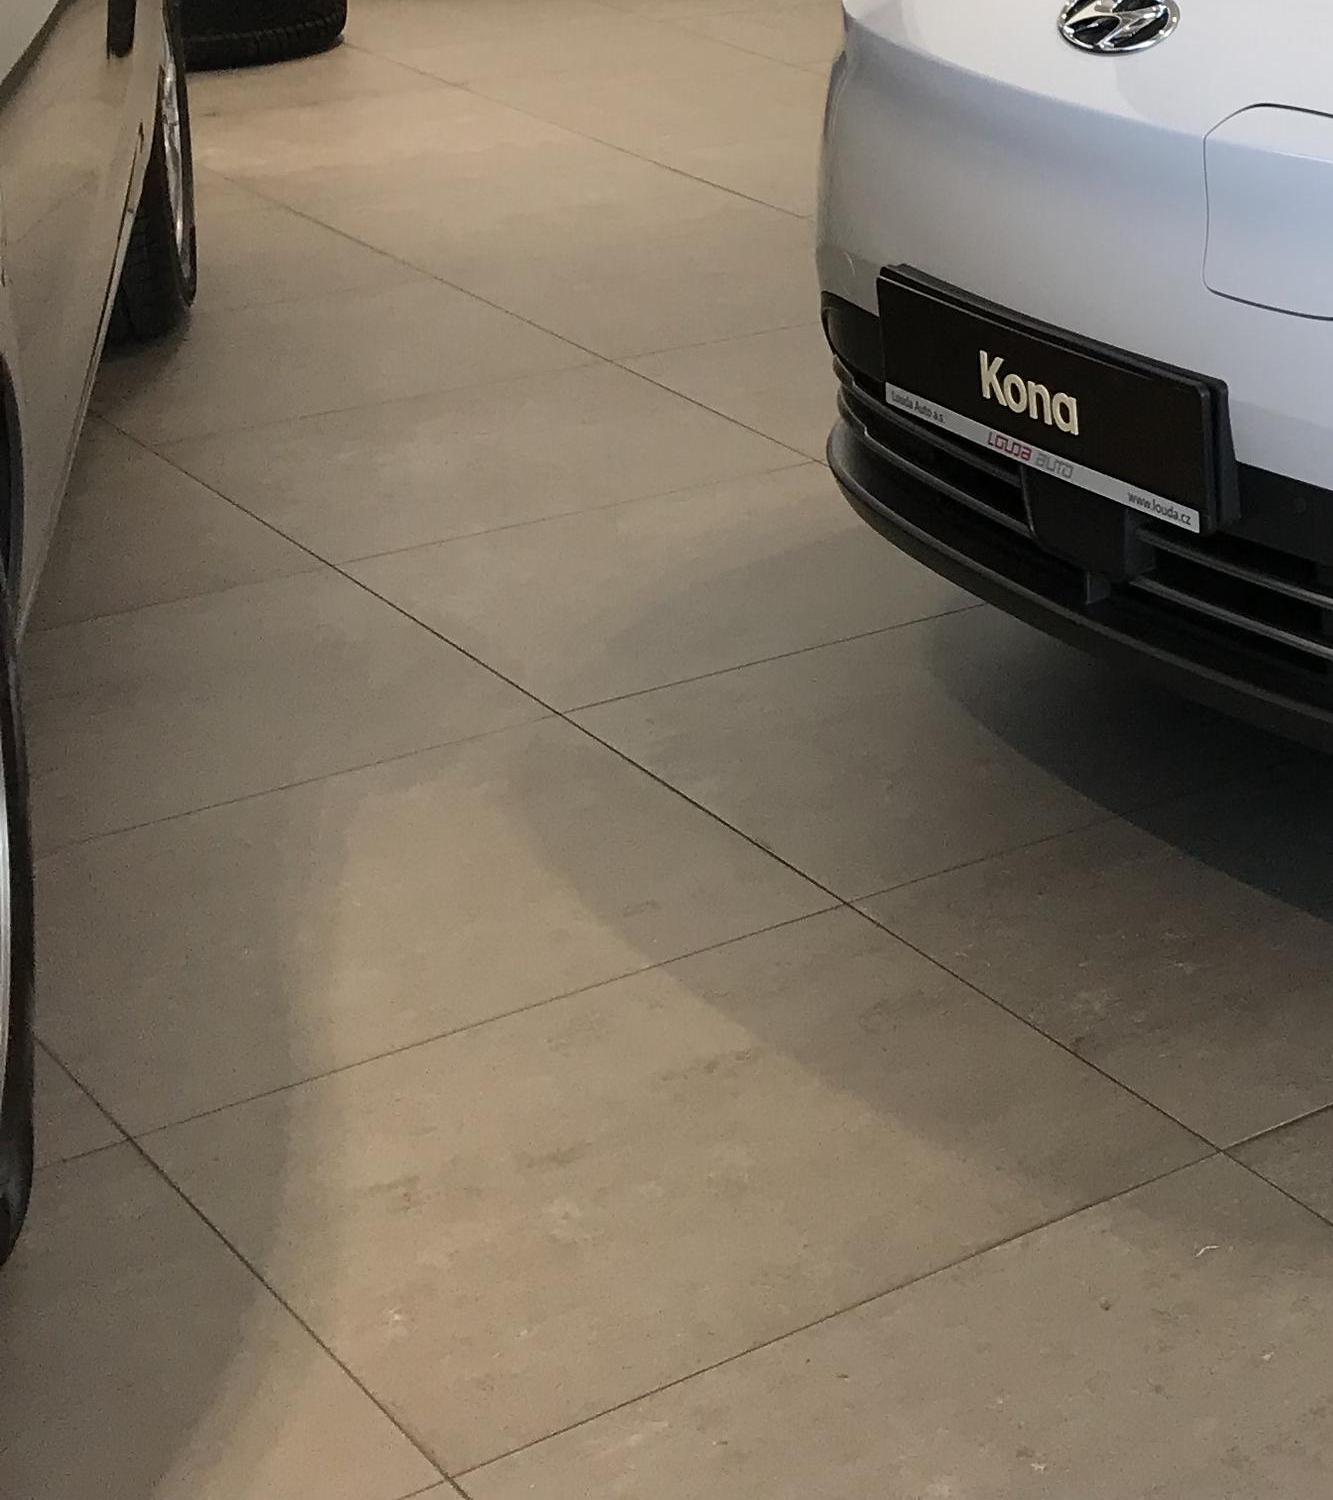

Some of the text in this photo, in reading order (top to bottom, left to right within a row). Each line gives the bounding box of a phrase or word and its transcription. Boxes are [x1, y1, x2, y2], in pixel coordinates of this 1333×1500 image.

[891, 389, 913, 410] Louda
[914, 400, 932, 418] Auto
[979, 349, 1080, 436] Kona
[1127, 491, 1192, 526] www.louda.cz
